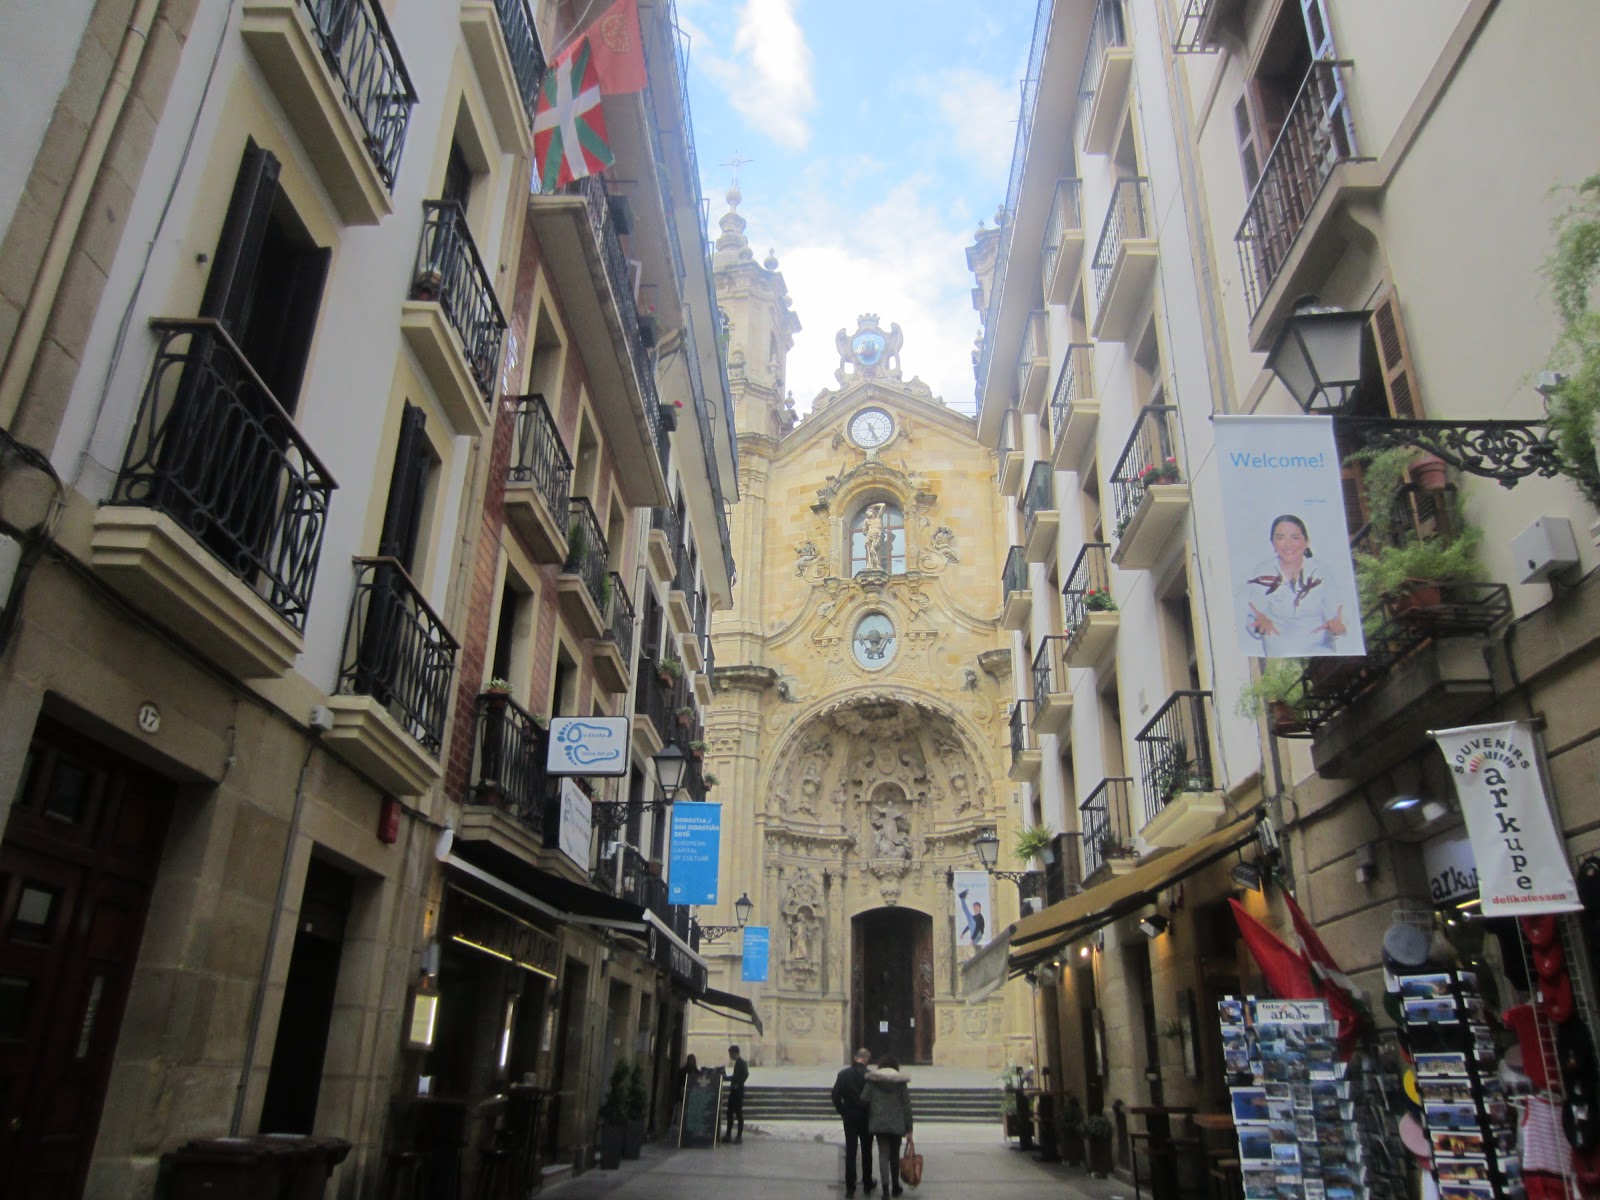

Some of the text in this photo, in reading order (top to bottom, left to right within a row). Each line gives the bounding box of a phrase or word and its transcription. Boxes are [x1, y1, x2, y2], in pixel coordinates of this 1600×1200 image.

[1230, 452, 1325, 468] Welcome!
[142, 708, 159, 727] 17
[1454, 737, 1530, 775] SOUVENIRS
[1483, 767, 1533, 890] arkupe
[1492, 893, 1567, 905] delikatessen
